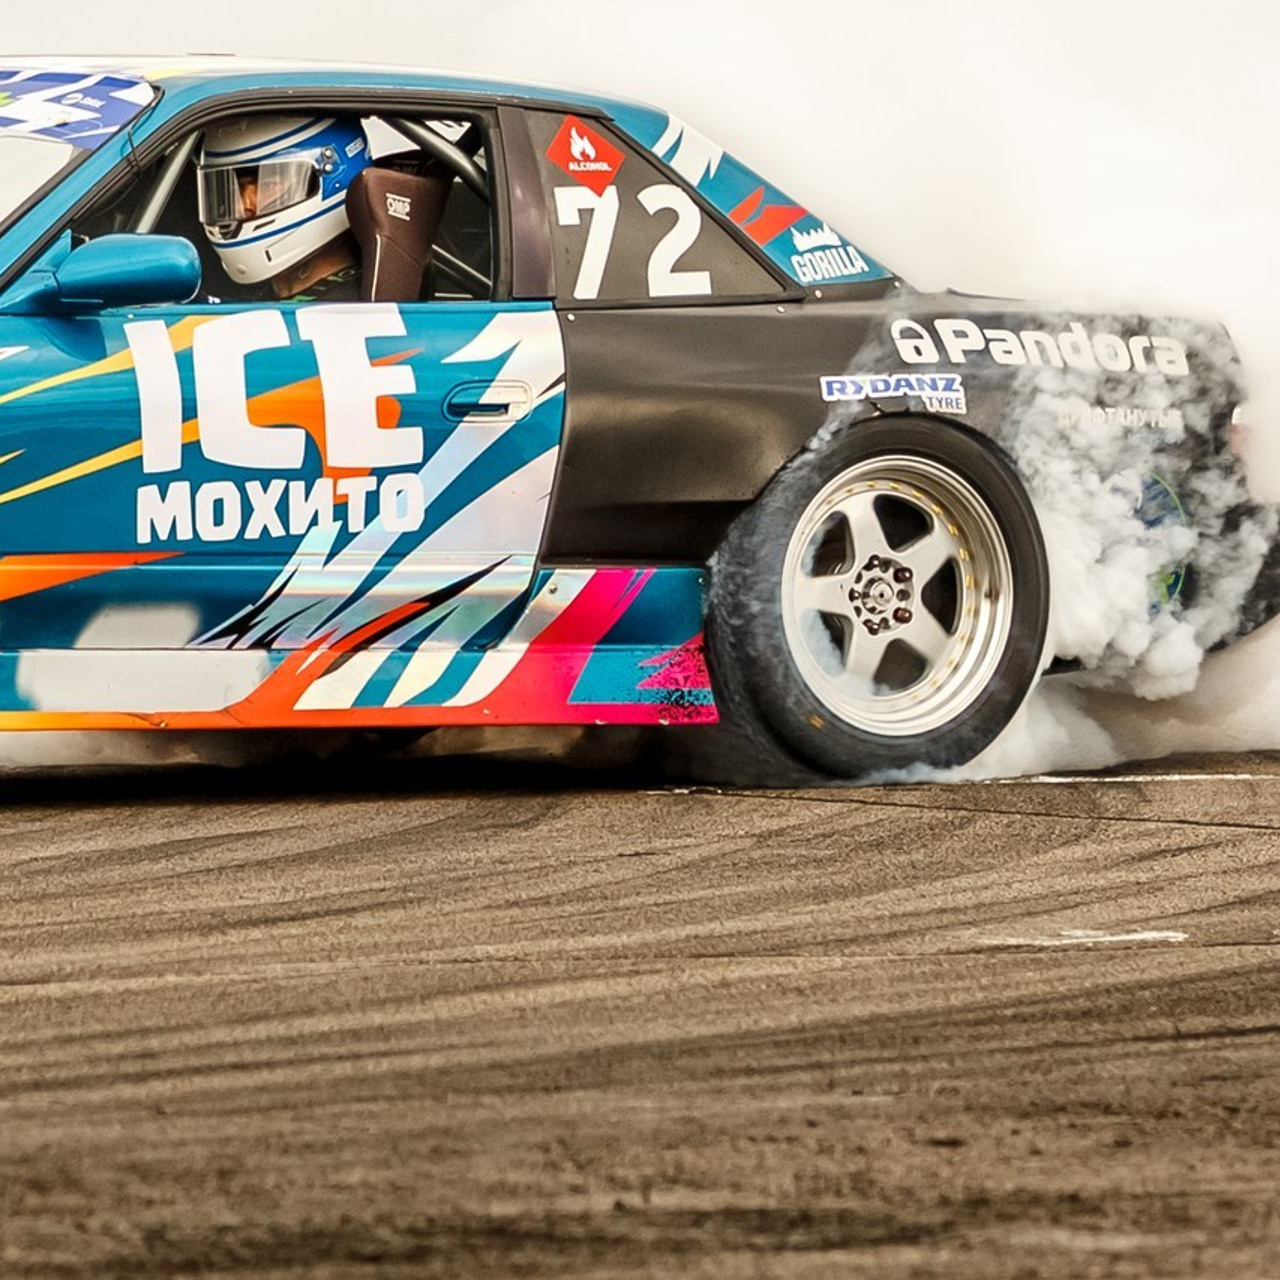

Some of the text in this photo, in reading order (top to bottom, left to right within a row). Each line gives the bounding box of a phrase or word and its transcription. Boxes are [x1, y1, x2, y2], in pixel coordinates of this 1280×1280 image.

[569, 161, 613, 172] ALCOHOL
[386, 196, 410, 217] OMP
[553, 184, 712, 300] 72
[790, 245, 870, 283] GORILLA
[933, 318, 1190, 376] Pandora
[123, 303, 424, 474] ICE
[825, 376, 961, 397] RYDANZ
[927, 395, 963, 410] TYRE
[136, 473, 425, 544] МОХИТО
